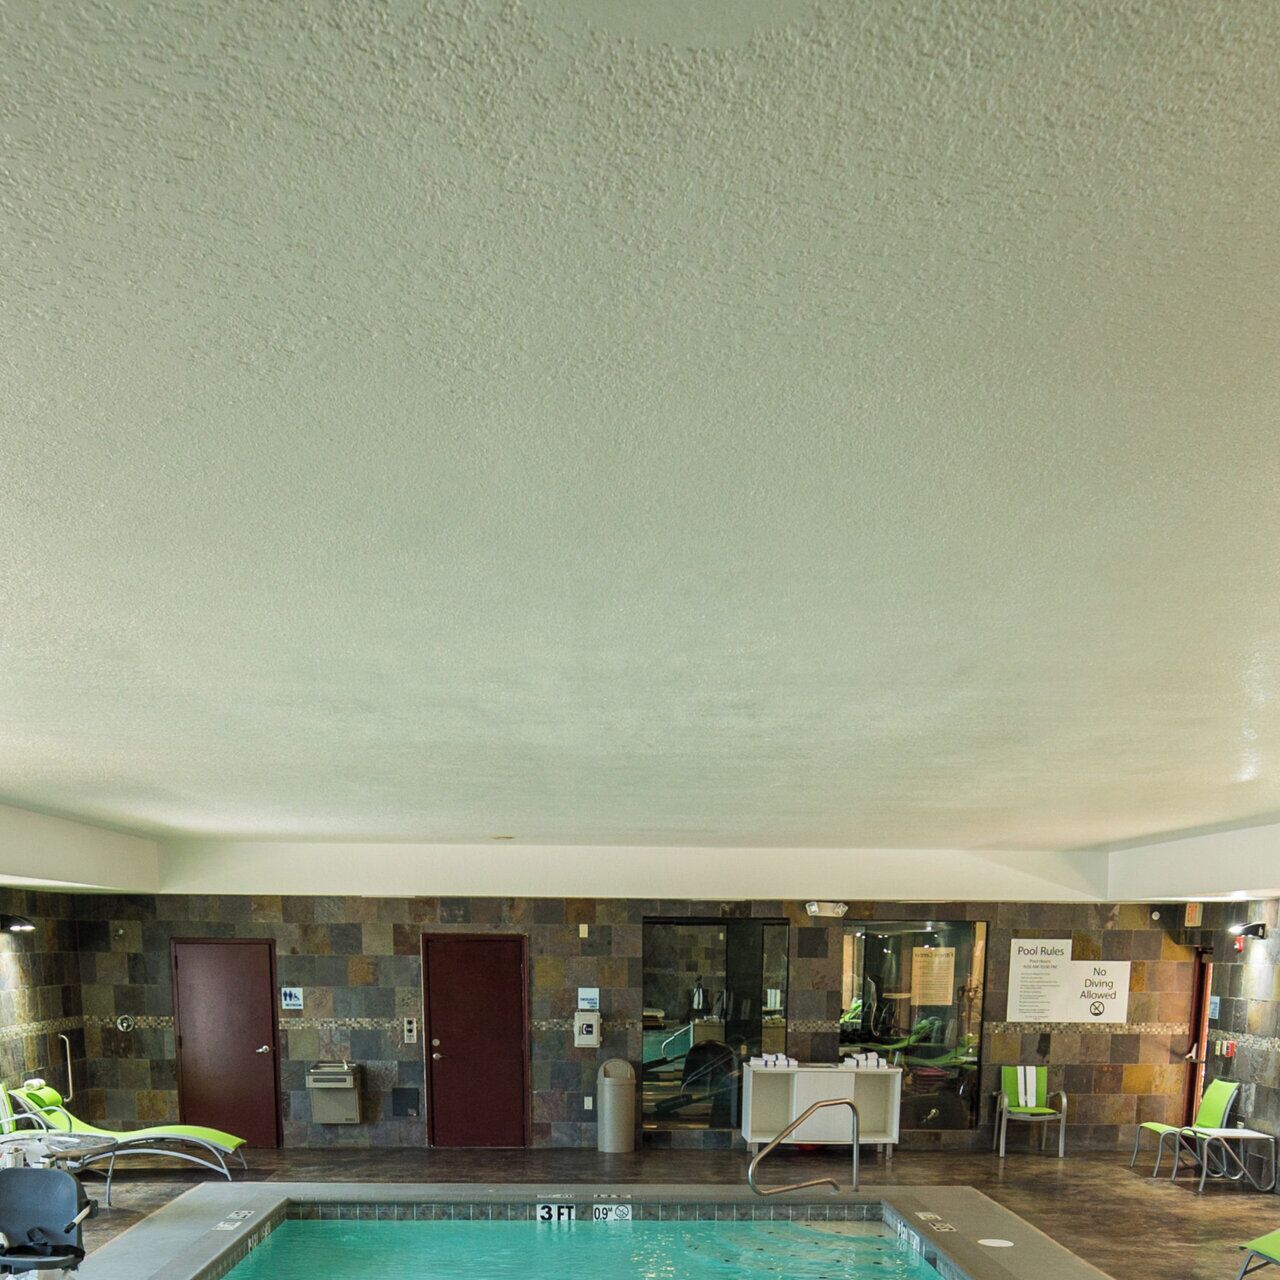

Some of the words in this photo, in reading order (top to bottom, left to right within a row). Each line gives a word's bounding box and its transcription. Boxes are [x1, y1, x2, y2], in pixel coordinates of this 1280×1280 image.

[1018, 946, 1038, 956] Pool
[1040, 946, 1064, 956] Rules
[1093, 968, 1106, 976] No
[1084, 979, 1114, 990] Diving
[1080, 990, 1116, 999] Allowed
[540, 1205, 553, 1220] 3
